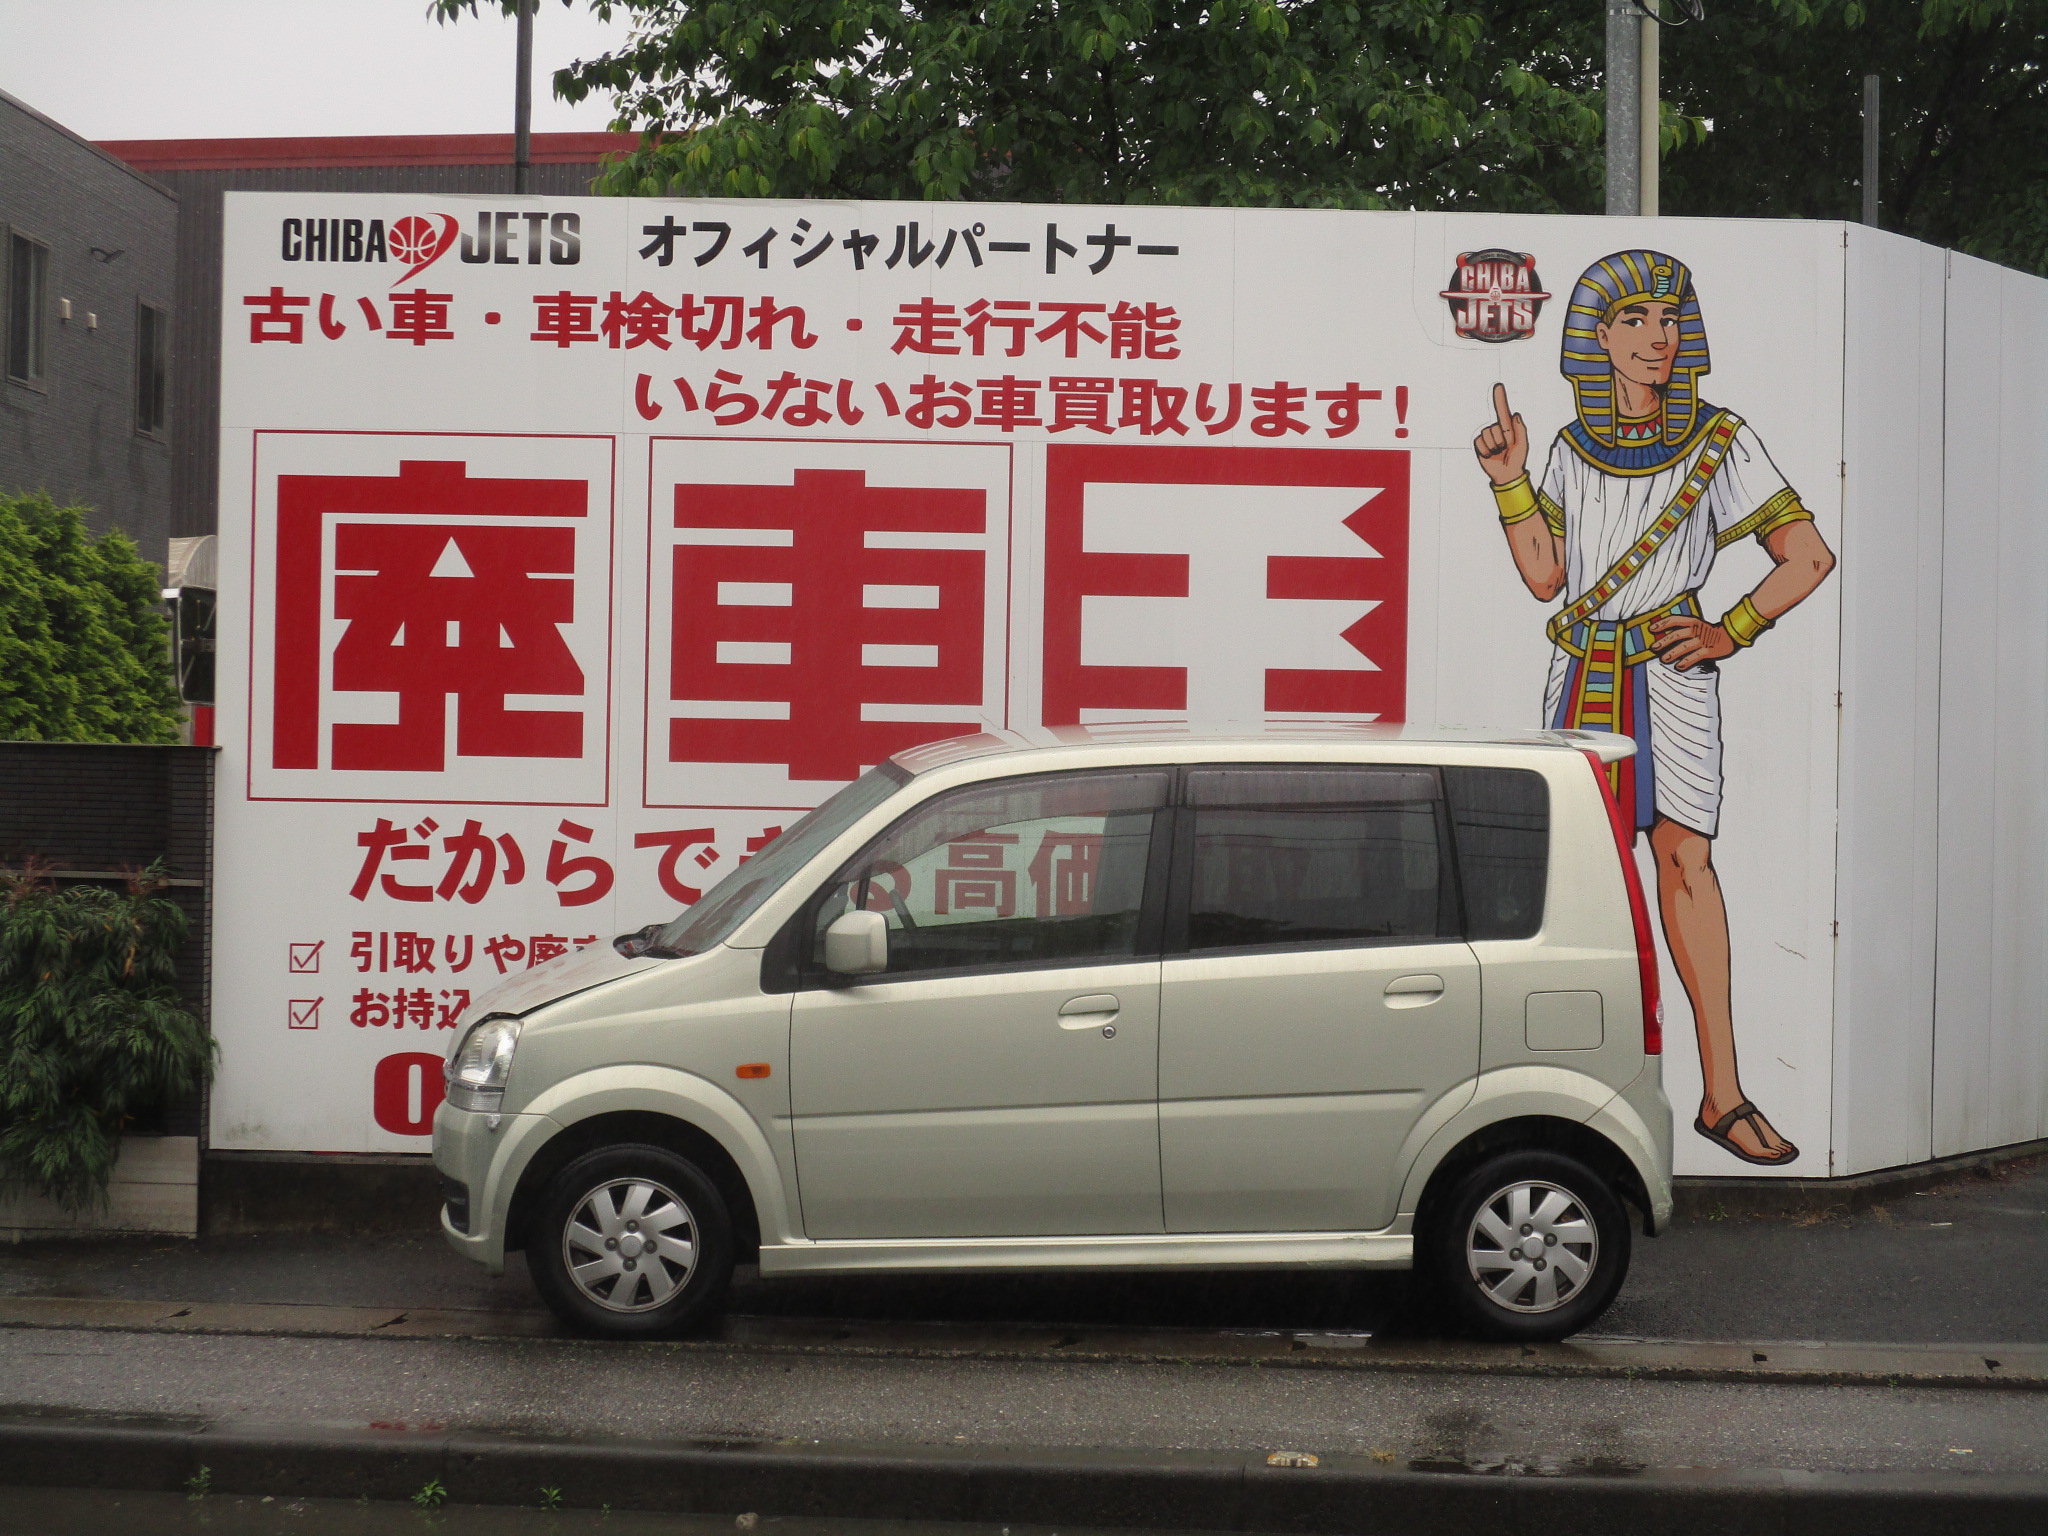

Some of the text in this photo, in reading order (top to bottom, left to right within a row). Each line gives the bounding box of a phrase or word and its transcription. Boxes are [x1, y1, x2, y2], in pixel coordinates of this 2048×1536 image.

[282, 211, 1181, 275] CHIBA JETS オフィシャルパートナー
[1460, 262, 1531, 293] CHIBA
[243, 286, 1182, 360] 古い車・車検切れ・走行不能
[1456, 299, 1534, 334] JETS
[634, 368, 1411, 440] いらないお車買取ります!
[350, 930, 600, 975] 引取りや廃
